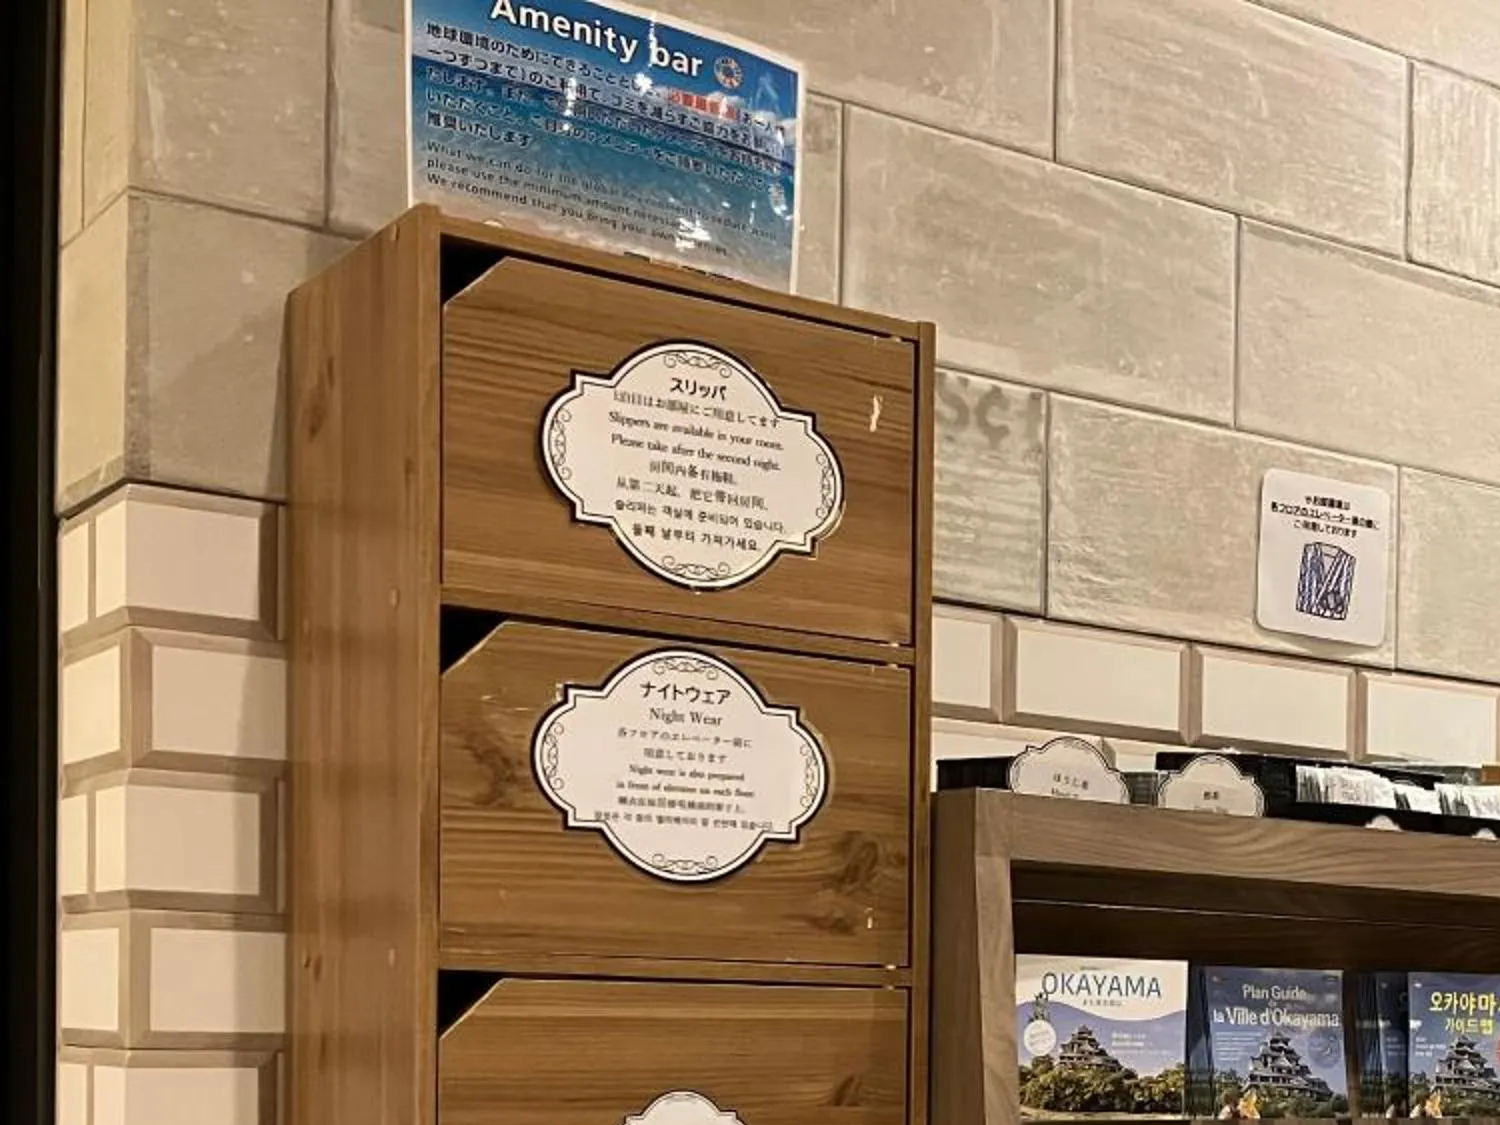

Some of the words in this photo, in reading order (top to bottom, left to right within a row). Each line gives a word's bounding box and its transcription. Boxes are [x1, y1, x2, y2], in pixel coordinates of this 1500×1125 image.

[490, 0, 639, 64] Amenity
[651, 37, 703, 78] bar
[670, 377, 727, 400] スリッパ
[608, 410, 650, 429] Slippers
[611, 432, 643, 448] Please
[647, 438, 668, 452] take
[697, 445, 713, 459] the
[640, 682, 731, 705] ナイトウェア
[649, 707, 684, 724] Night
[689, 711, 723, 726] Wear
[1042, 972, 1162, 998] OKAYAMA
[1242, 983, 1269, 999] Plan
[1213, 1008, 1225, 1023] la
[1225, 1006, 1257, 1025] Ville
